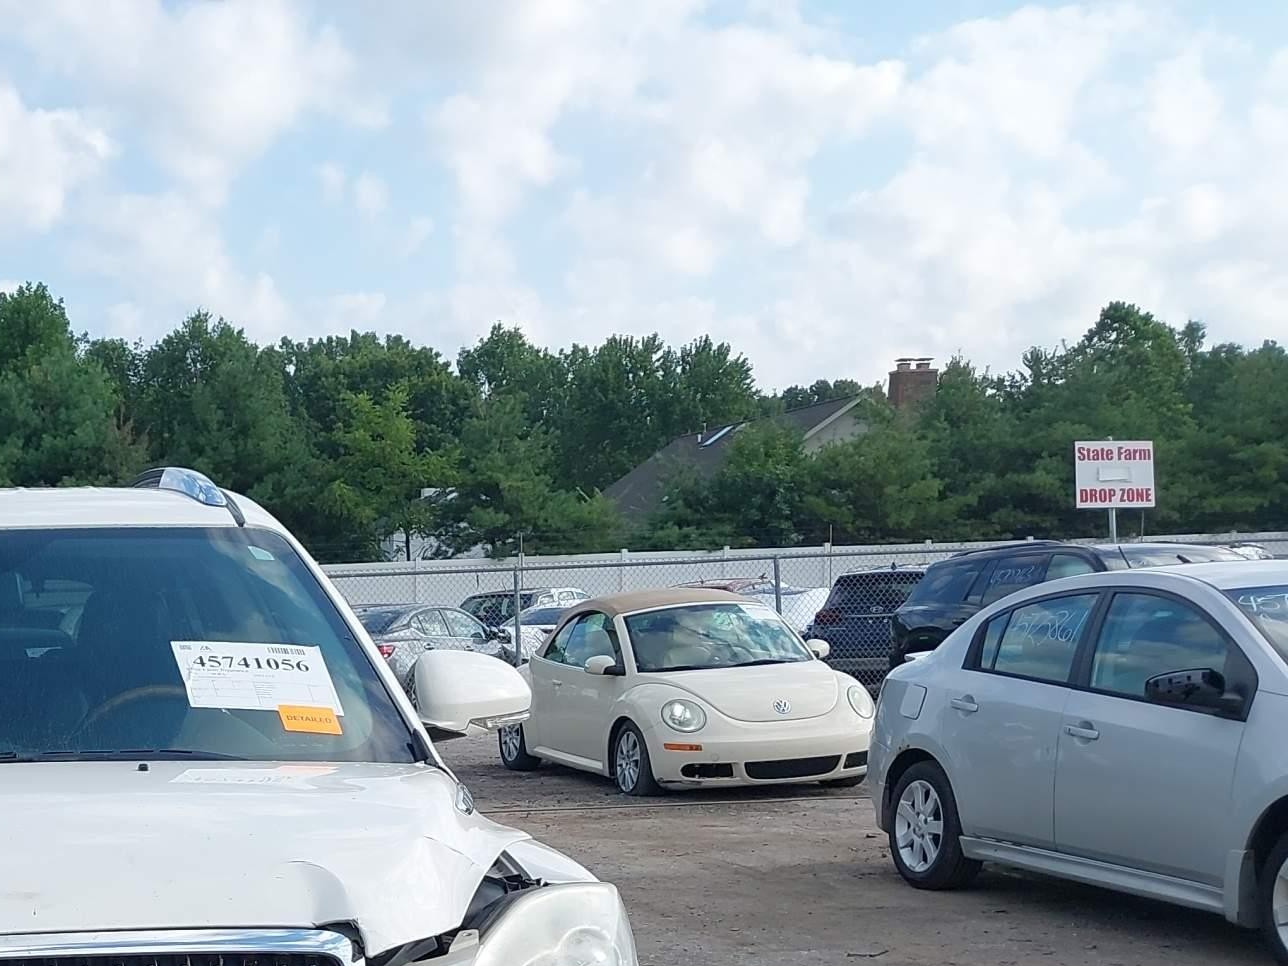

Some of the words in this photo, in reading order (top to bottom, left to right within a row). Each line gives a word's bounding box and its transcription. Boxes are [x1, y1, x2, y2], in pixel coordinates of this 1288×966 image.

[1077, 446, 1114, 461] State
[1117, 446, 1152, 461] Farm
[1079, 488, 1116, 503] DROP
[1119, 487, 1152, 503] ZONE
[192, 655, 310, 673] 45741056
[286, 714, 333, 724] DETAILED
